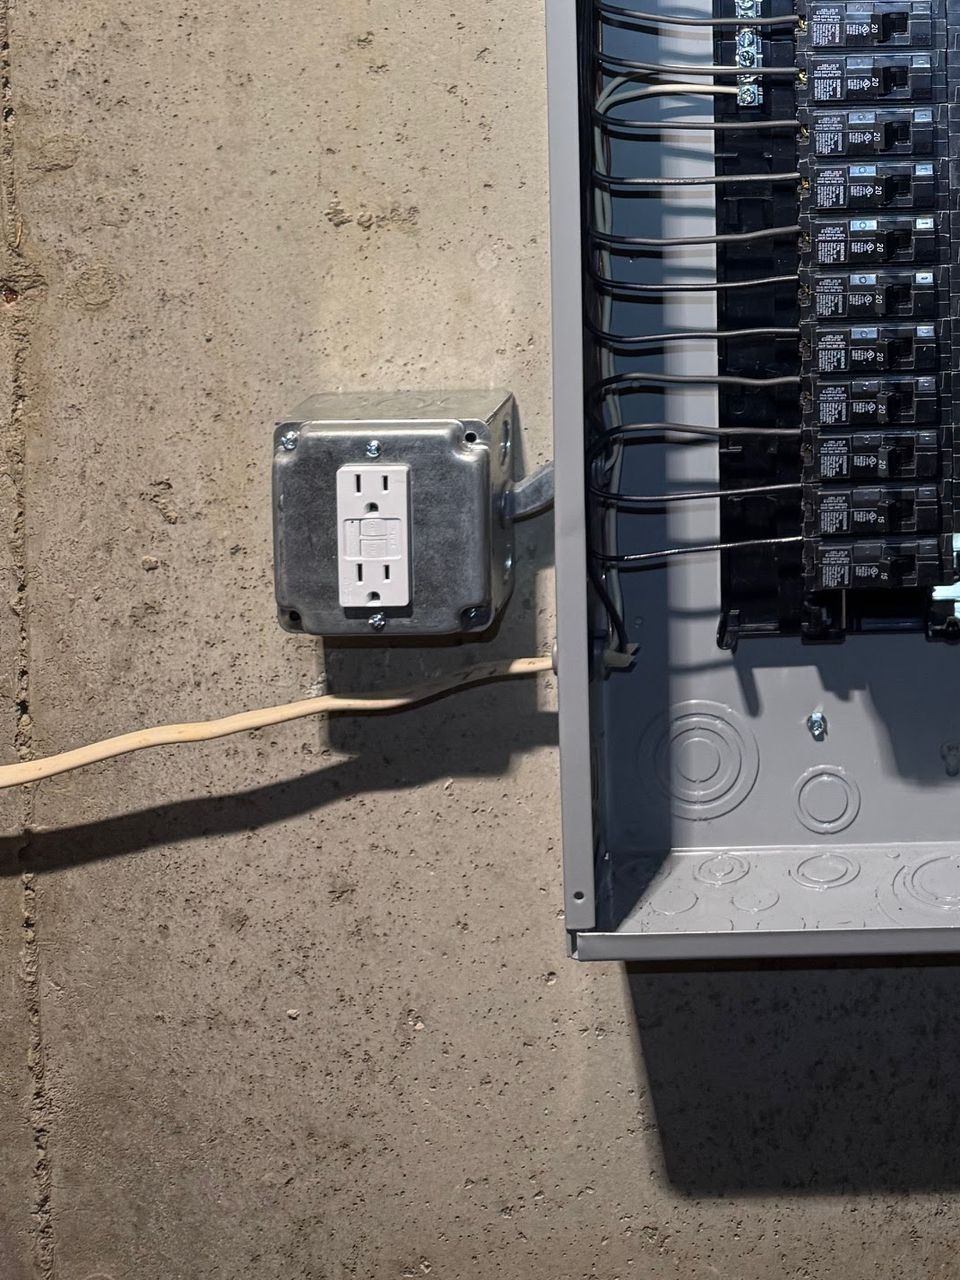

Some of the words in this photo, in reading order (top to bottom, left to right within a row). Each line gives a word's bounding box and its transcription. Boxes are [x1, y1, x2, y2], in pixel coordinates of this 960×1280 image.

[872, 24, 878, 34] 20
[872, 78, 879, 88] 20
[874, 132, 880, 142] 20
[875, 186, 882, 196] 20
[877, 243, 883, 253] 20
[876, 295, 882, 304] 20
[877, 353, 883, 362] 20
[879, 405, 885, 414] 20
[879, 460, 886, 469] 20
